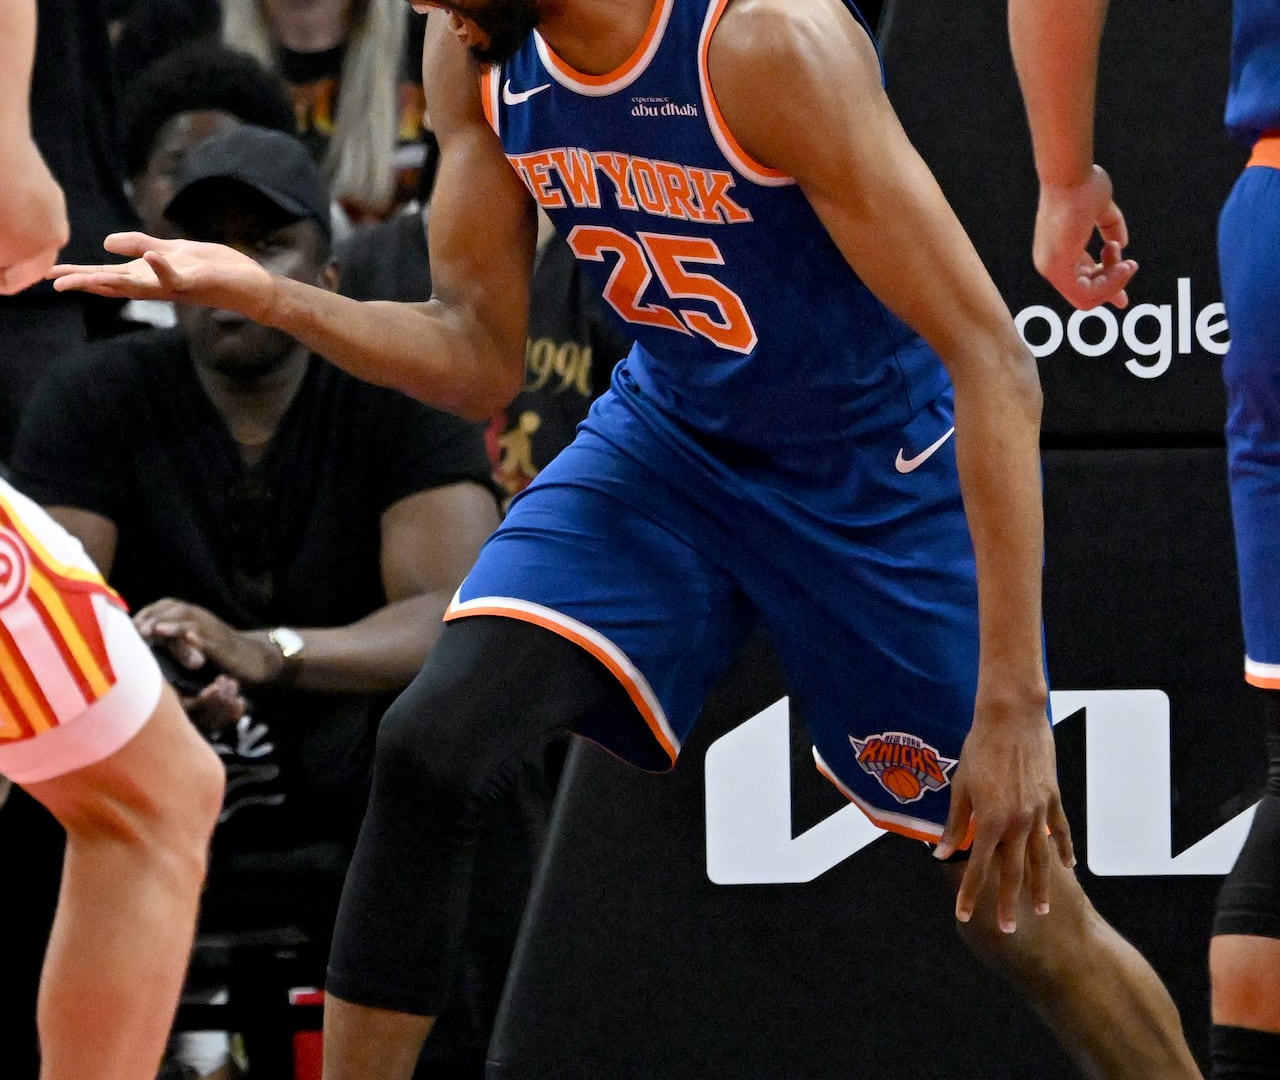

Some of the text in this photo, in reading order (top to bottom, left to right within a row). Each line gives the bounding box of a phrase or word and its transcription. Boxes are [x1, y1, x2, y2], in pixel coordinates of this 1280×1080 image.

[631, 103, 699, 117] abu dhabi
[594, 151, 754, 225] YORK
[565, 224, 759, 356] 25
[1014, 277, 1233, 379] oogle
[858, 738, 947, 786] KNICKS
